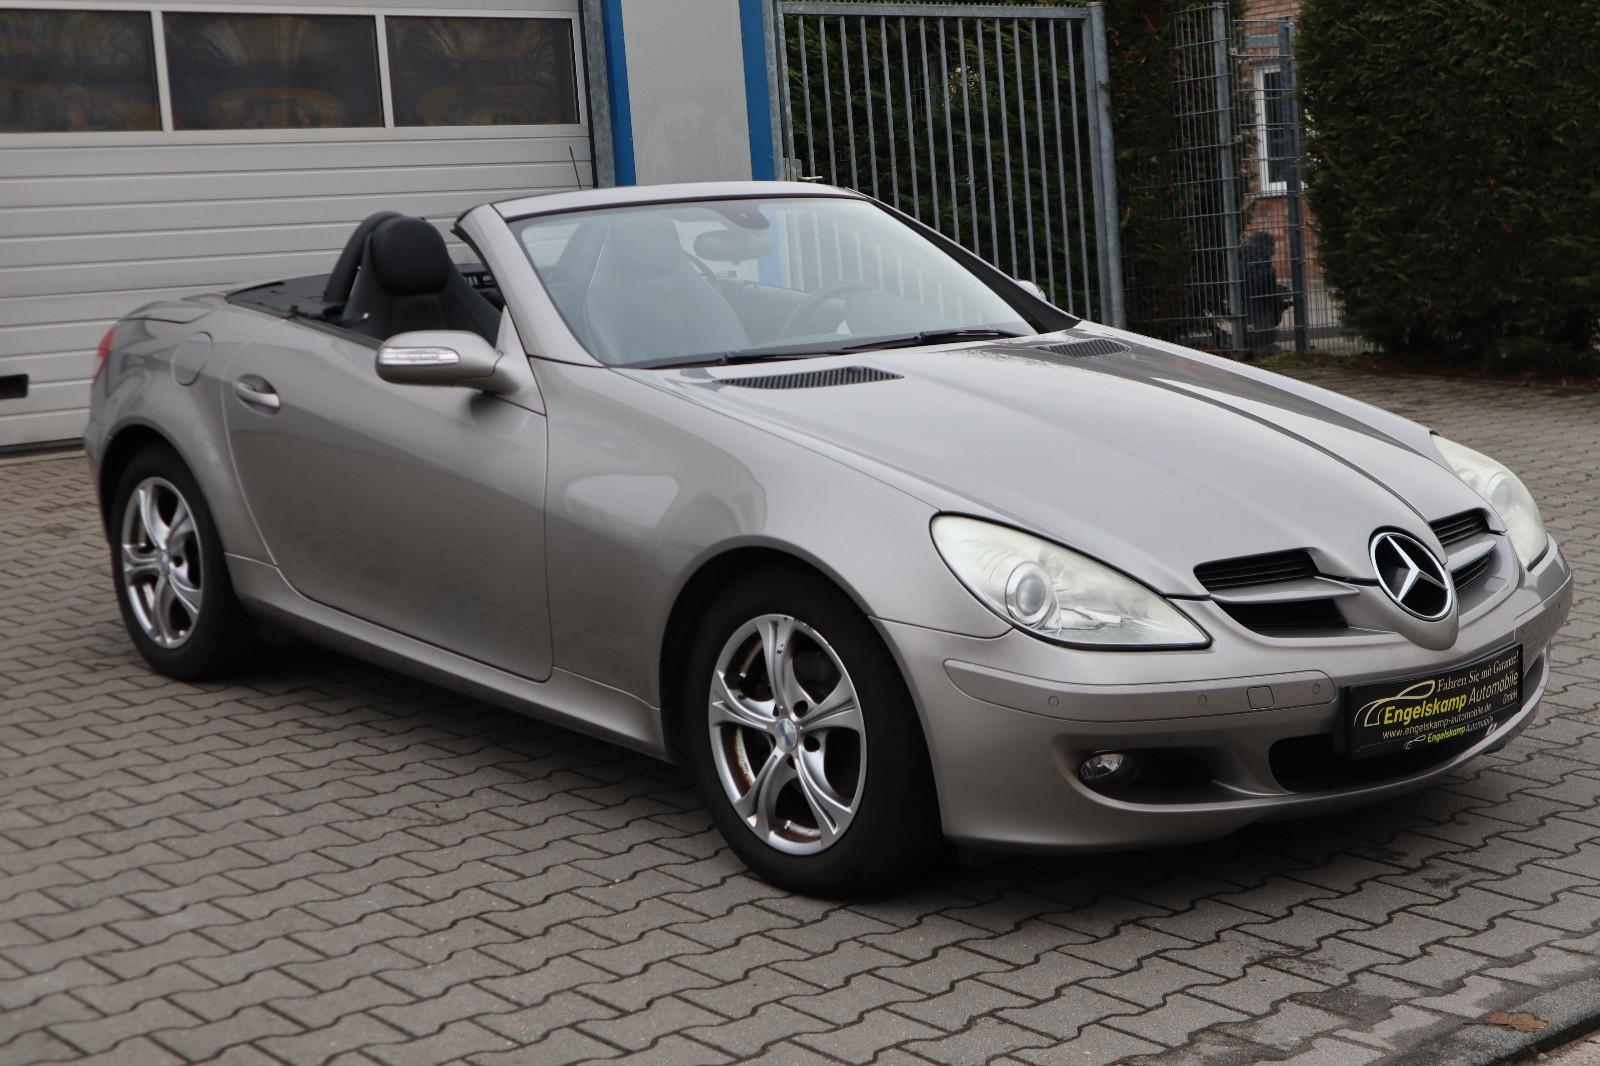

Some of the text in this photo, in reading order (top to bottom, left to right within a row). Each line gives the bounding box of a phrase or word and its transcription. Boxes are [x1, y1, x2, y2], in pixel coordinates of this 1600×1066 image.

[1437, 676, 1467, 692] Fahren
[1469, 669, 1480, 683] Sie
[1481, 664, 1492, 680] mit
[1383, 670, 1519, 726] Engelskamp Automobile
[1427, 725, 1466, 743] Engelskamp
